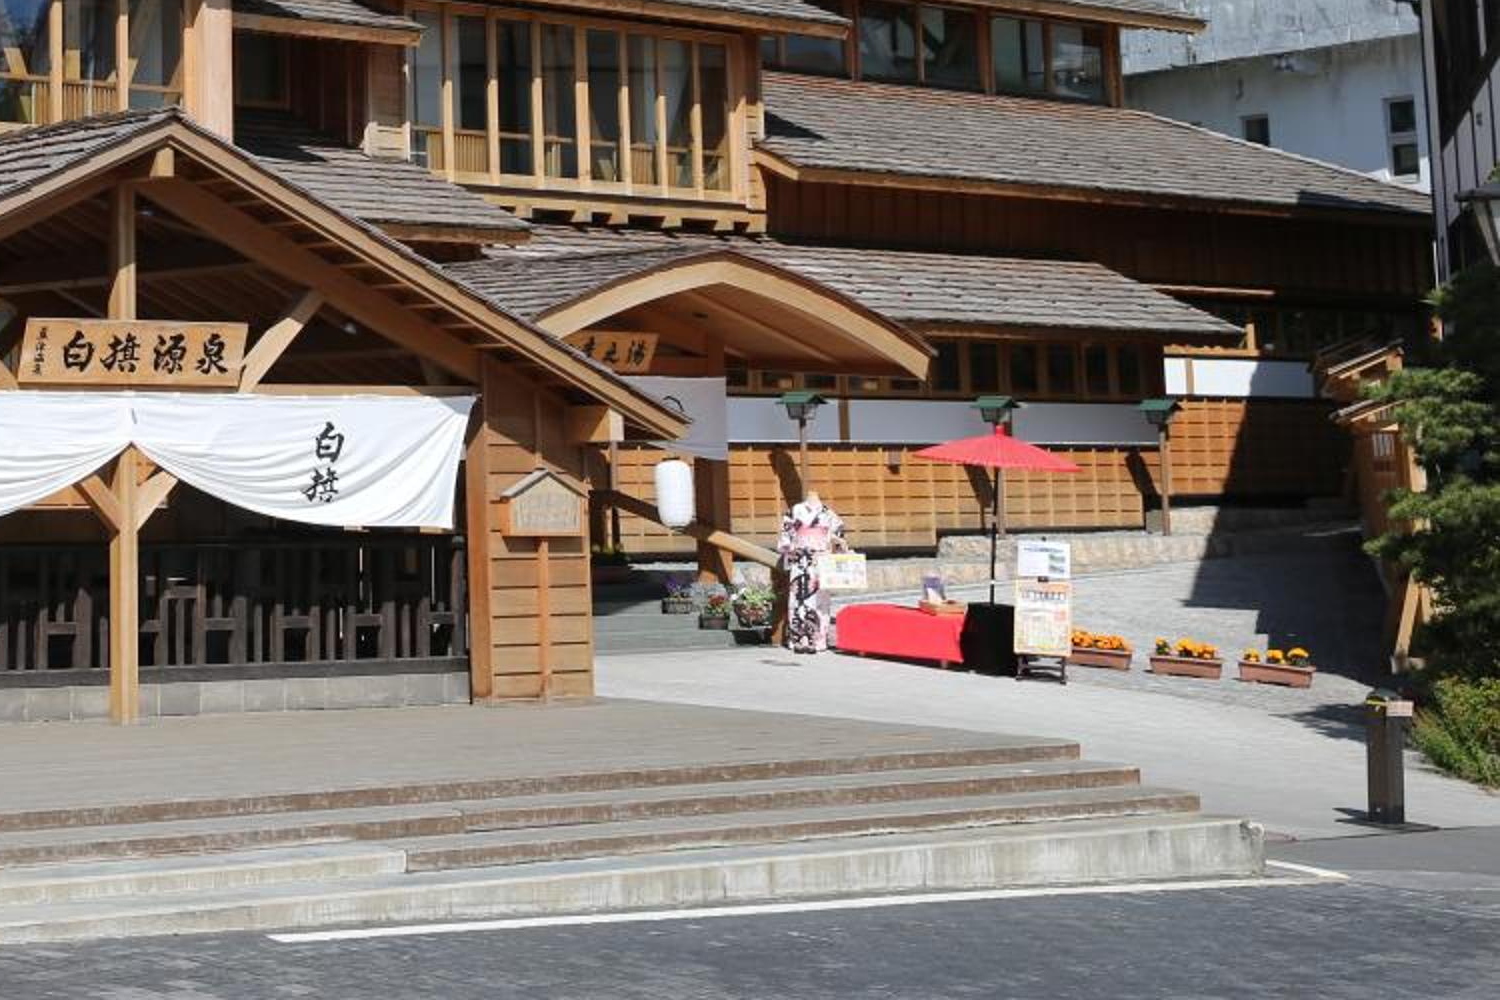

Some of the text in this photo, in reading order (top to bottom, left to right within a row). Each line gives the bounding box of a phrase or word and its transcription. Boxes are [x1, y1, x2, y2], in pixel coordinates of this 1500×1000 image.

[62, 330, 228, 374] 白旗源泉
[301, 421, 345, 503] 白旗
